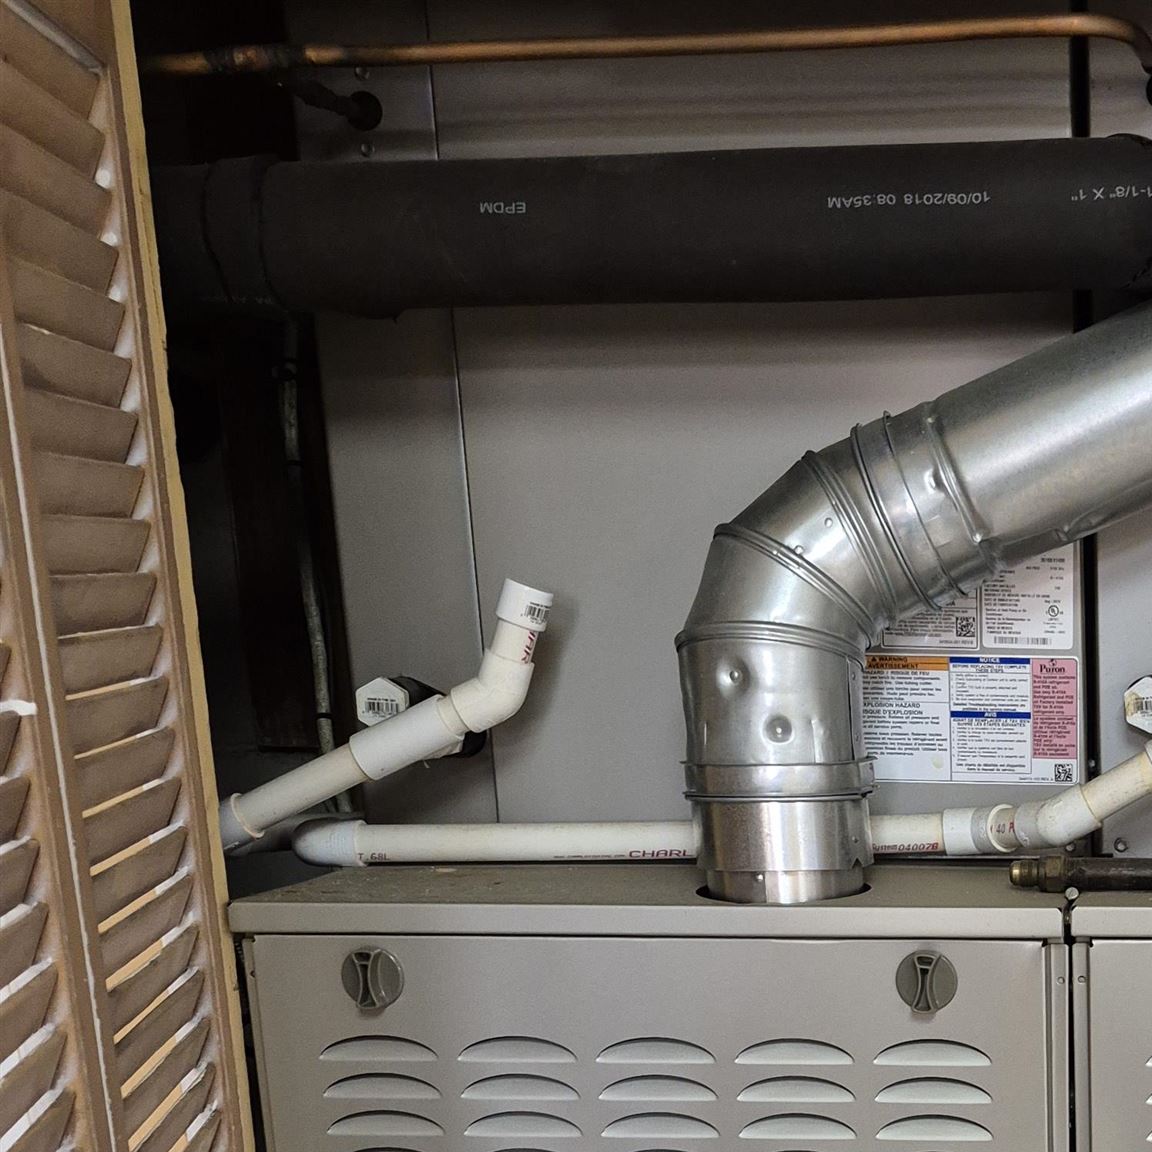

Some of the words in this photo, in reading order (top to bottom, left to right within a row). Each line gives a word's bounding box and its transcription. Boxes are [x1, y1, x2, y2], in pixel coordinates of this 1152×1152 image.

[904, 191, 990, 205] 10/09/2018
[1071, 189, 1087, 201] 1"
[1092, 187, 1104, 200] X
[480, 202, 526, 214] EPDM
[1040, 664, 1066, 673] Puron
